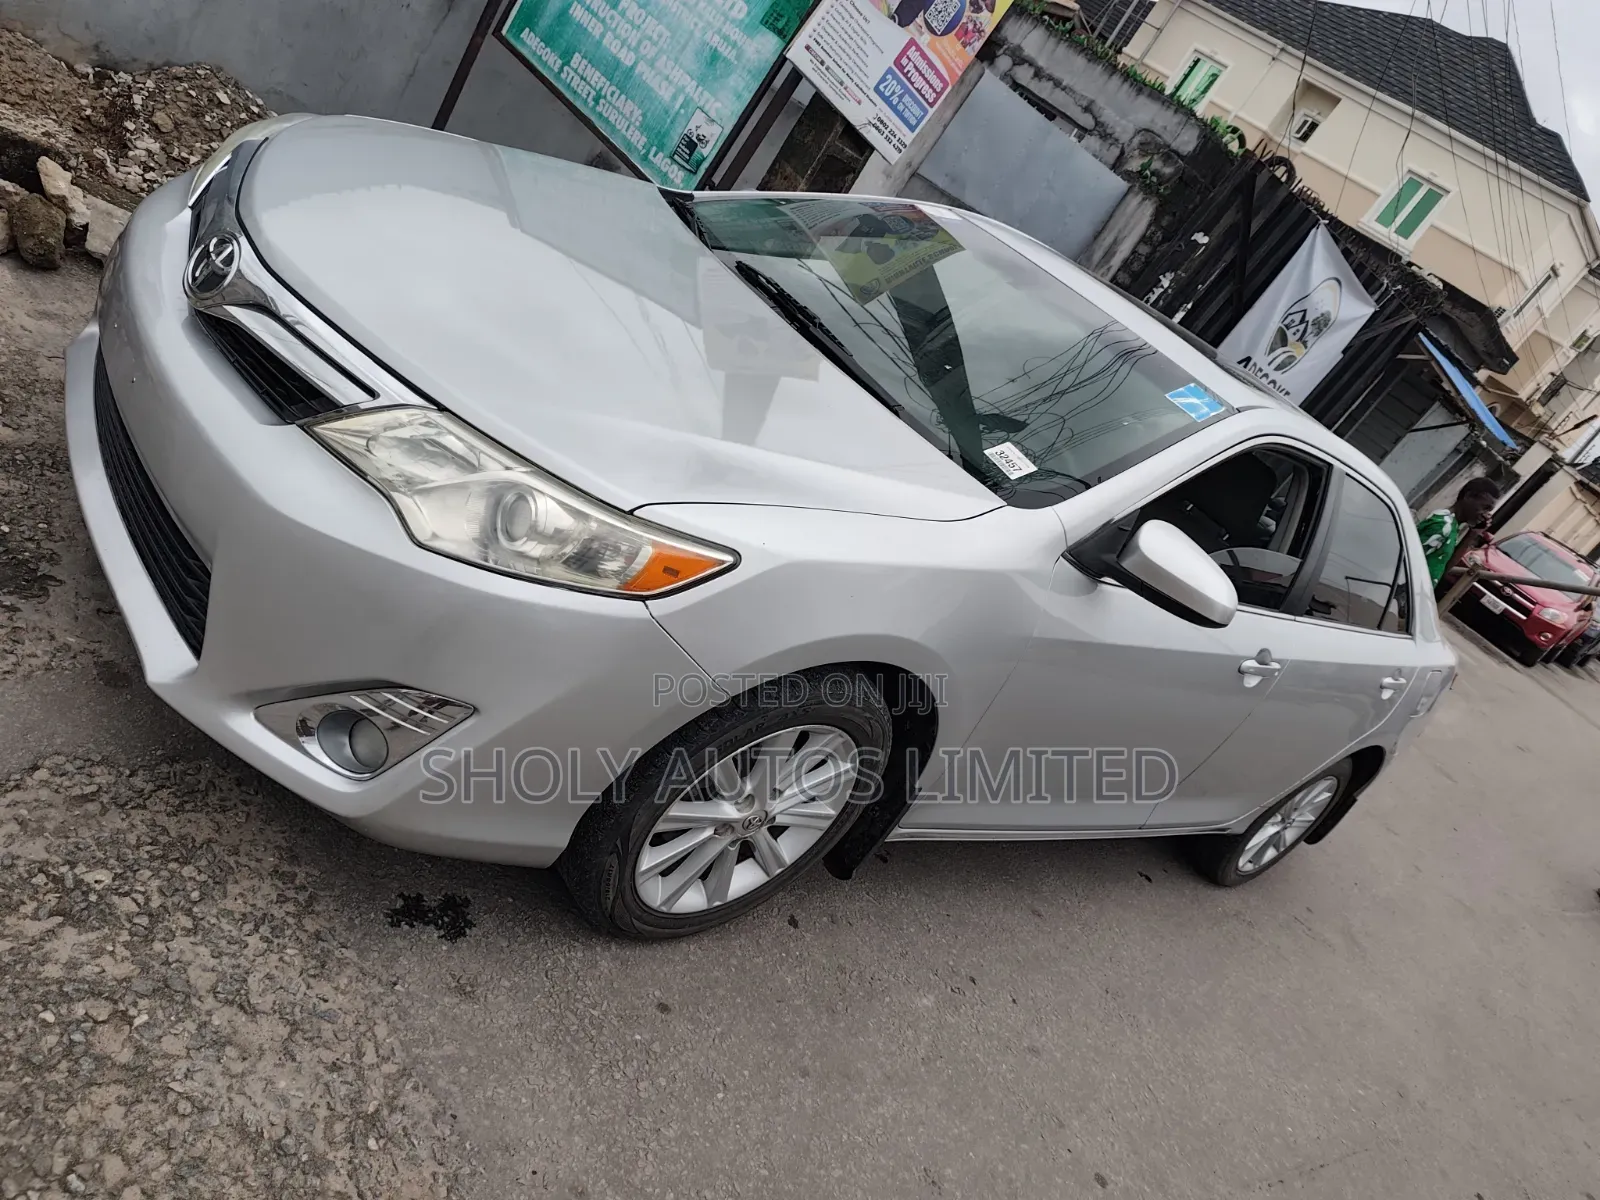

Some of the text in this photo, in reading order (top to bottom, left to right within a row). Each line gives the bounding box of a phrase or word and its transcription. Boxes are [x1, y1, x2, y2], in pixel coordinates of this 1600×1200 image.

[569, 1, 604, 39] INNER
[603, 31, 636, 67] ROAD
[635, 60, 676, 102] PHASE
[906, 45, 944, 92] Admissions
[520, 27, 562, 72] ADEGOKE
[561, 65, 597, 107] STREET,
[596, 98, 647, 155] SURULERE,
[570, 52, 643, 127] BENEFICIARY:
[640, 39, 659, 60] OF
[655, 54, 723, 117] ASHPALTIC
[879, 74, 905, 105] 20%
[900, 54, 937, 103] in Progress
[896, 101, 905, 113] ON
[902, 107, 918, 126] TUITION
[901, 93, 924, 120] DISCOUNT
[995, 450, 1023, 472] 32457
